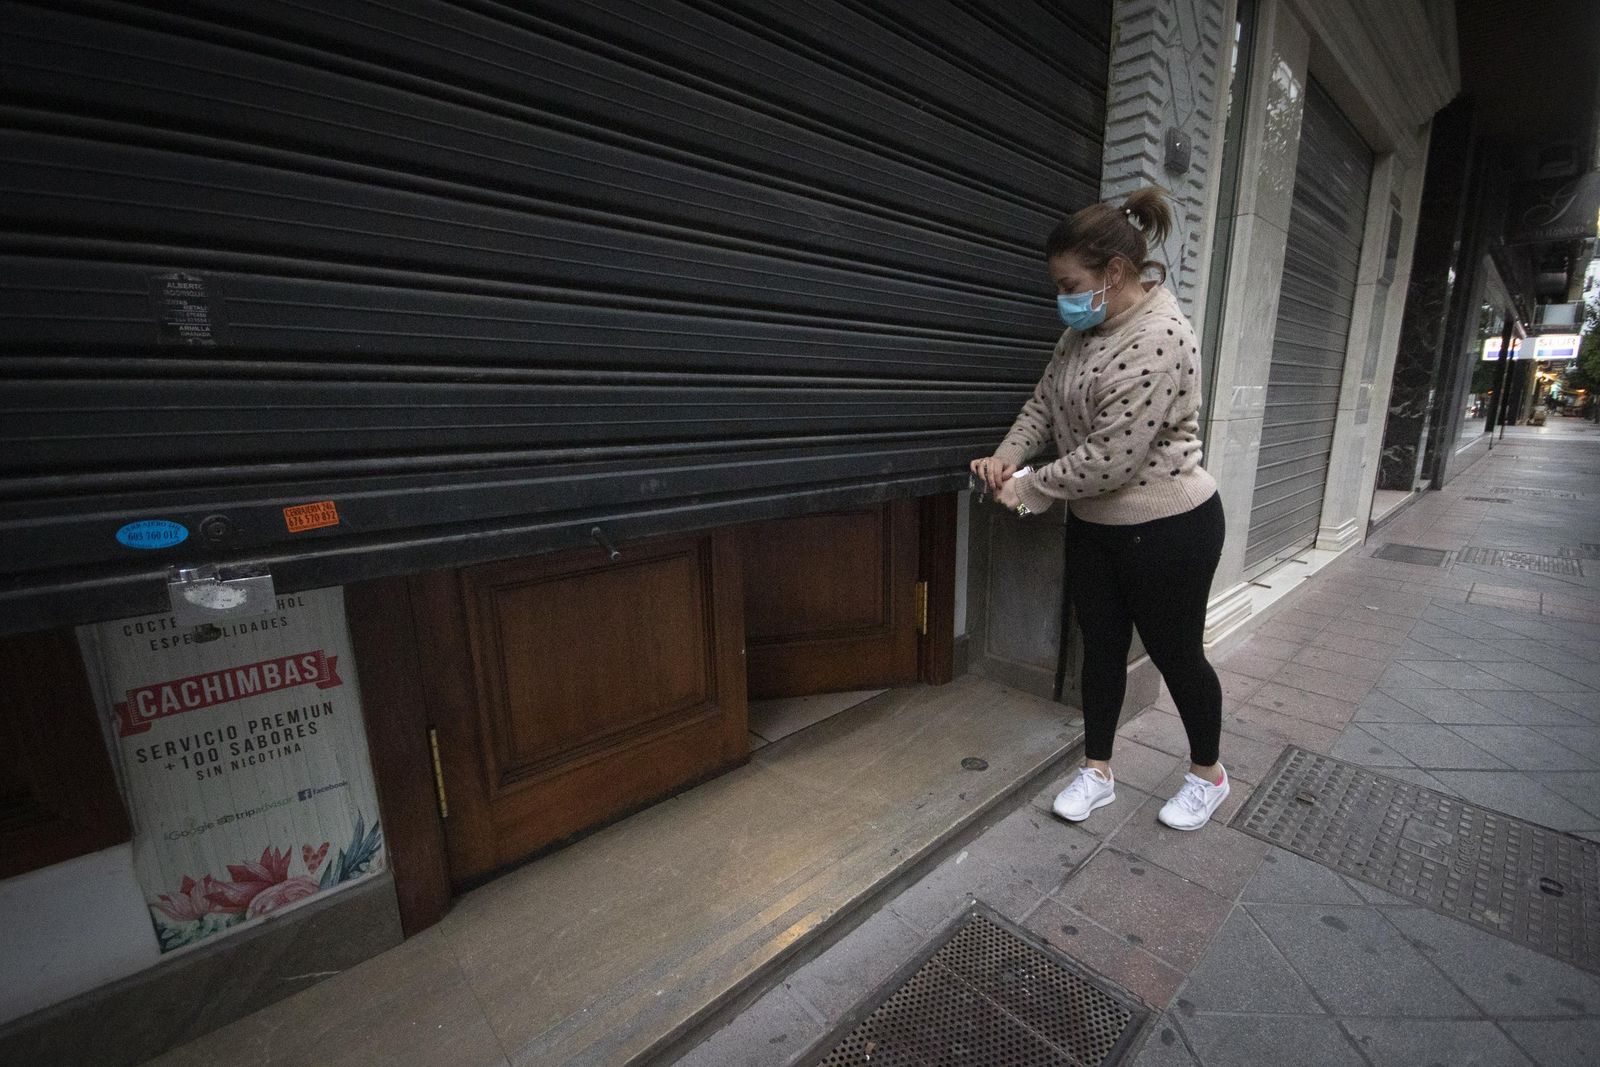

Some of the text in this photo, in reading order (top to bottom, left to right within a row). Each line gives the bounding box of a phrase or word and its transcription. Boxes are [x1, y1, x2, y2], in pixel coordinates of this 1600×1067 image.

[305, 513, 320, 523] 570
[123, 597, 305, 637] COCTE HOL
[150, 616, 288, 651] ESPELIDADES
[136, 656, 318, 717] CACHIMBAS
[136, 701, 334, 763] SERVICIO PREMIUN
[229, 722, 317, 756] SABORES
[197, 743, 302, 781] SIN NICOTINA
[313, 780, 348, 795] facebook
